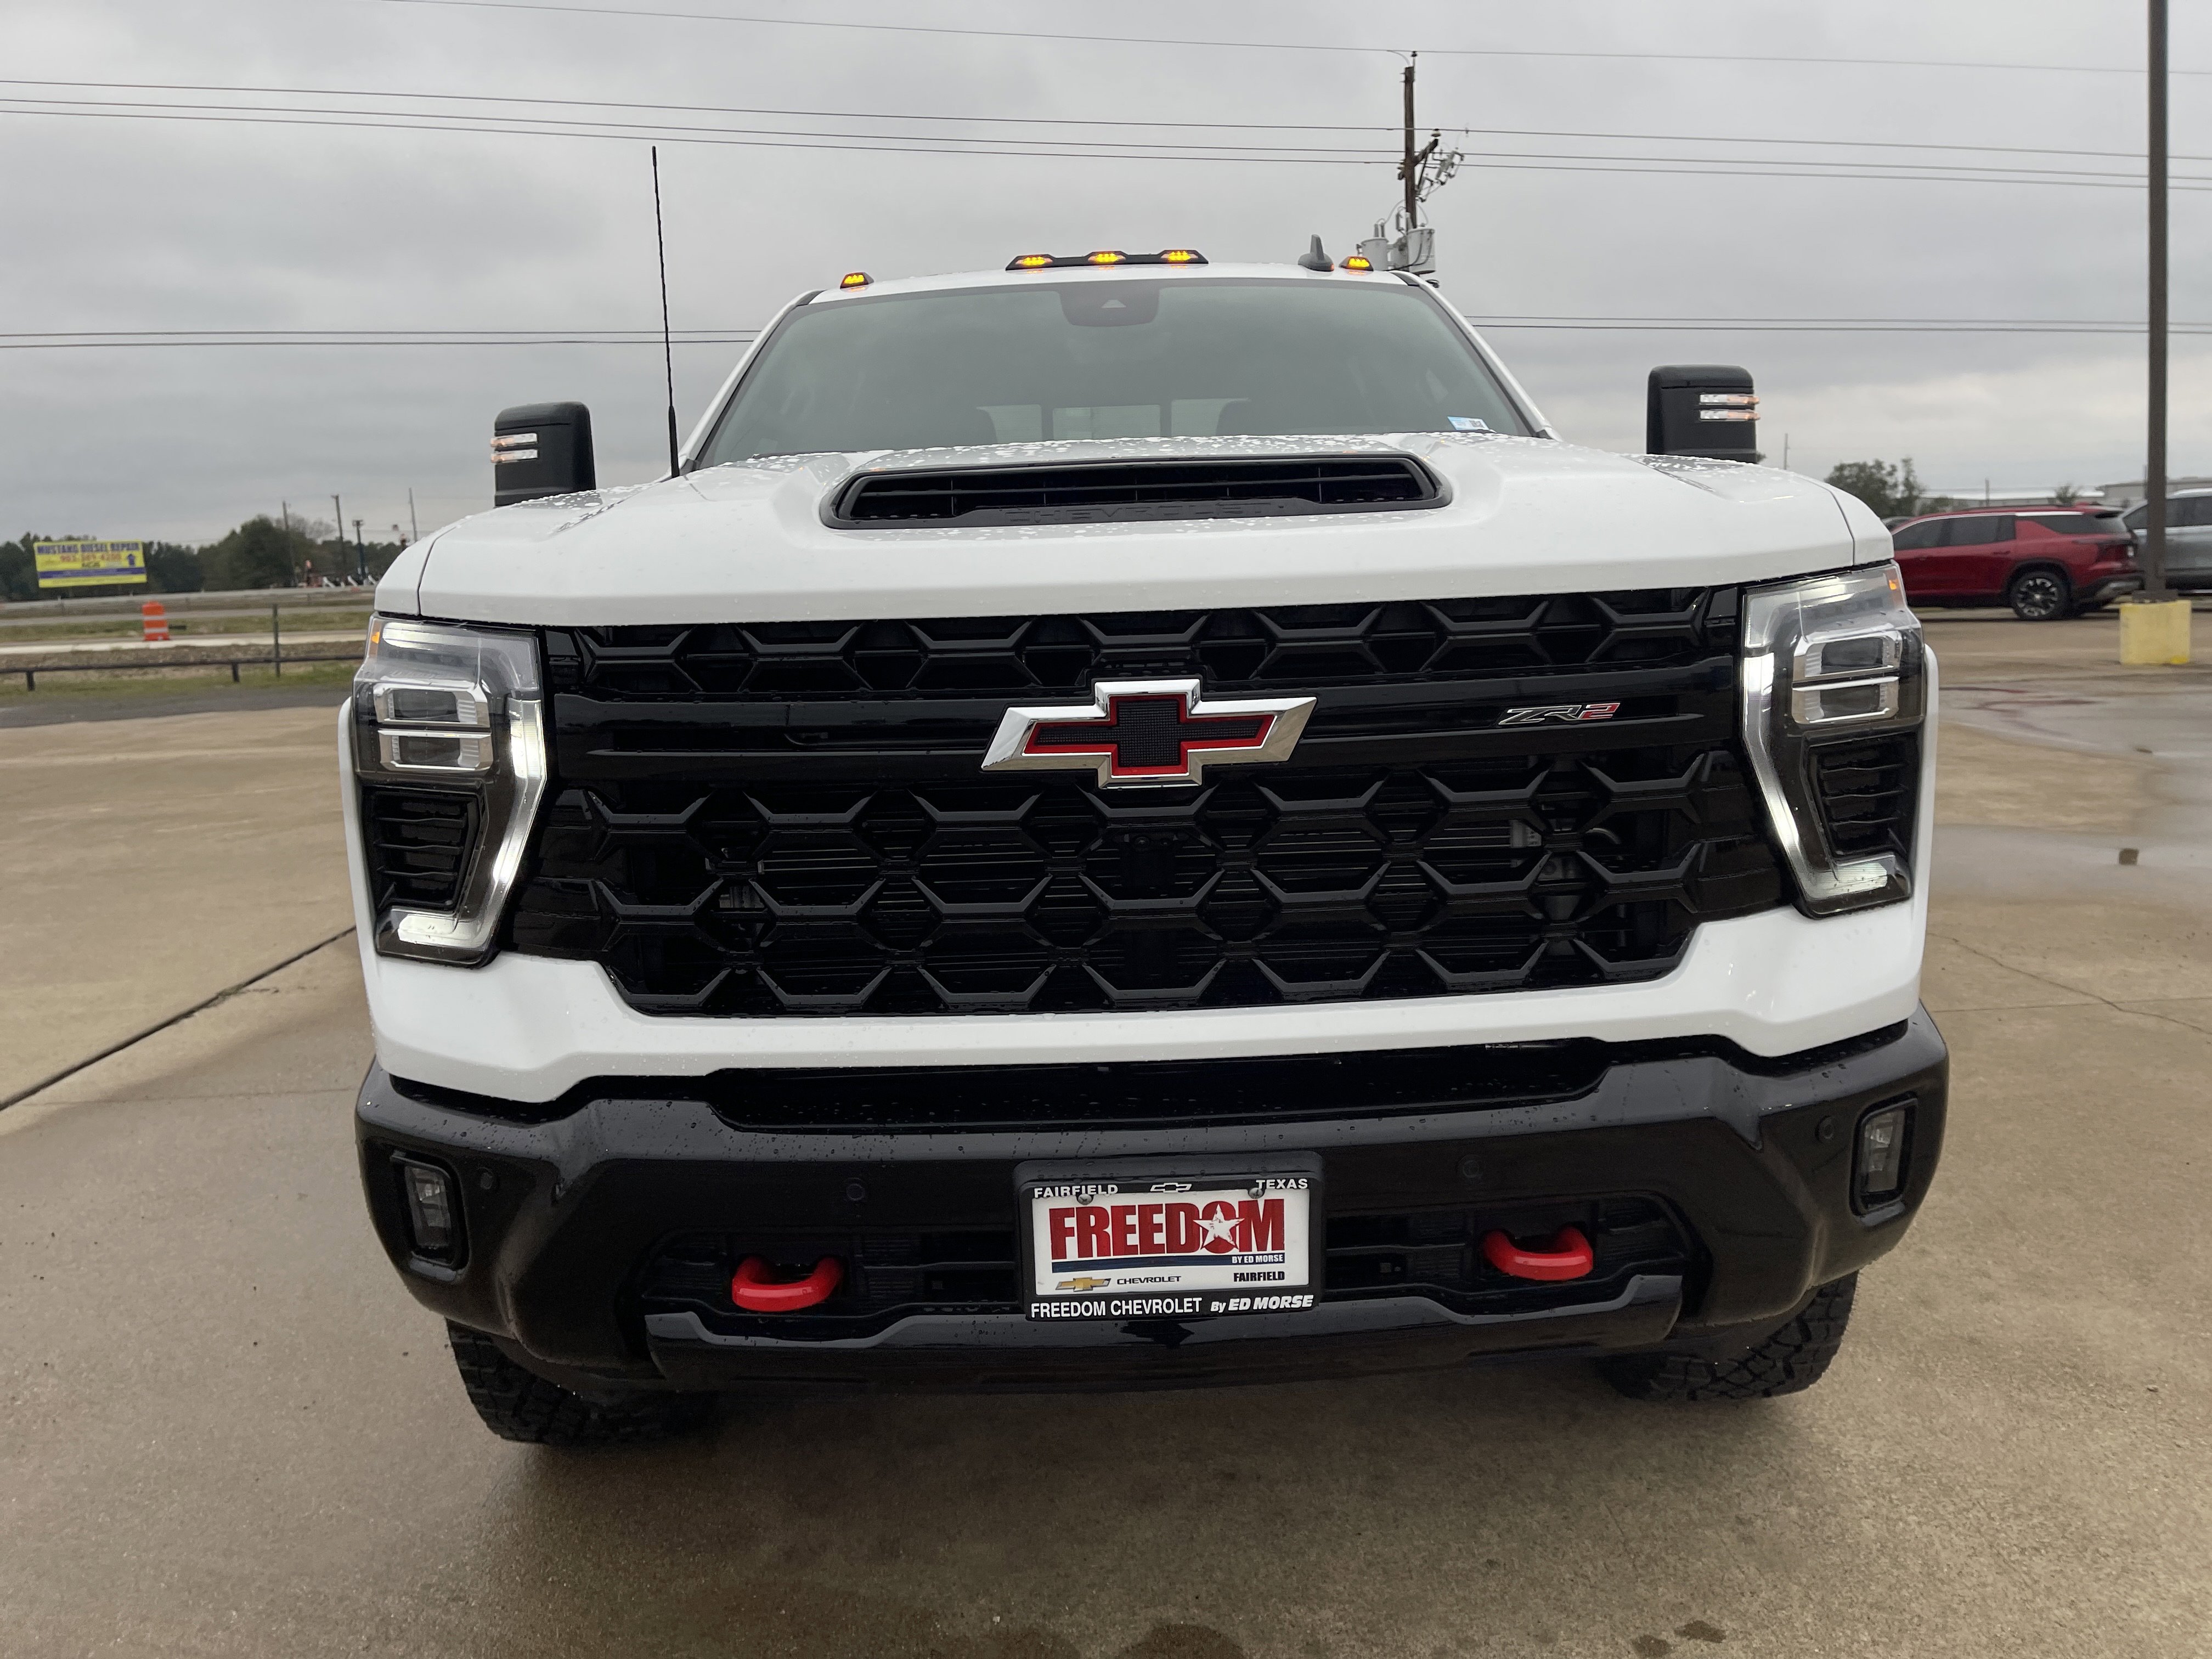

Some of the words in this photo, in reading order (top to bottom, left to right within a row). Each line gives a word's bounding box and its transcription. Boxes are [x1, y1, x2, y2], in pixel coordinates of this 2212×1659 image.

[1498, 702, 1620, 725] ZR2
[1034, 1184, 1118, 1198] FAIRFIELD
[1255, 1178, 1308, 1189] TEXAS
[1049, 1199, 1285, 1260] FREEDOM
[1256, 1254, 1283, 1263] MORSE
[1117, 1276, 1182, 1285] CHEVROLET
[1233, 1271, 1285, 1282] FAIRFIELD
[1031, 1301, 1106, 1318] FREEDOM
[1110, 1297, 1203, 1316] CHEVROLET
[1210, 1301, 1226, 1313] By
[1228, 1297, 1251, 1311] ED
[1253, 1295, 1314, 1310] MORSE
